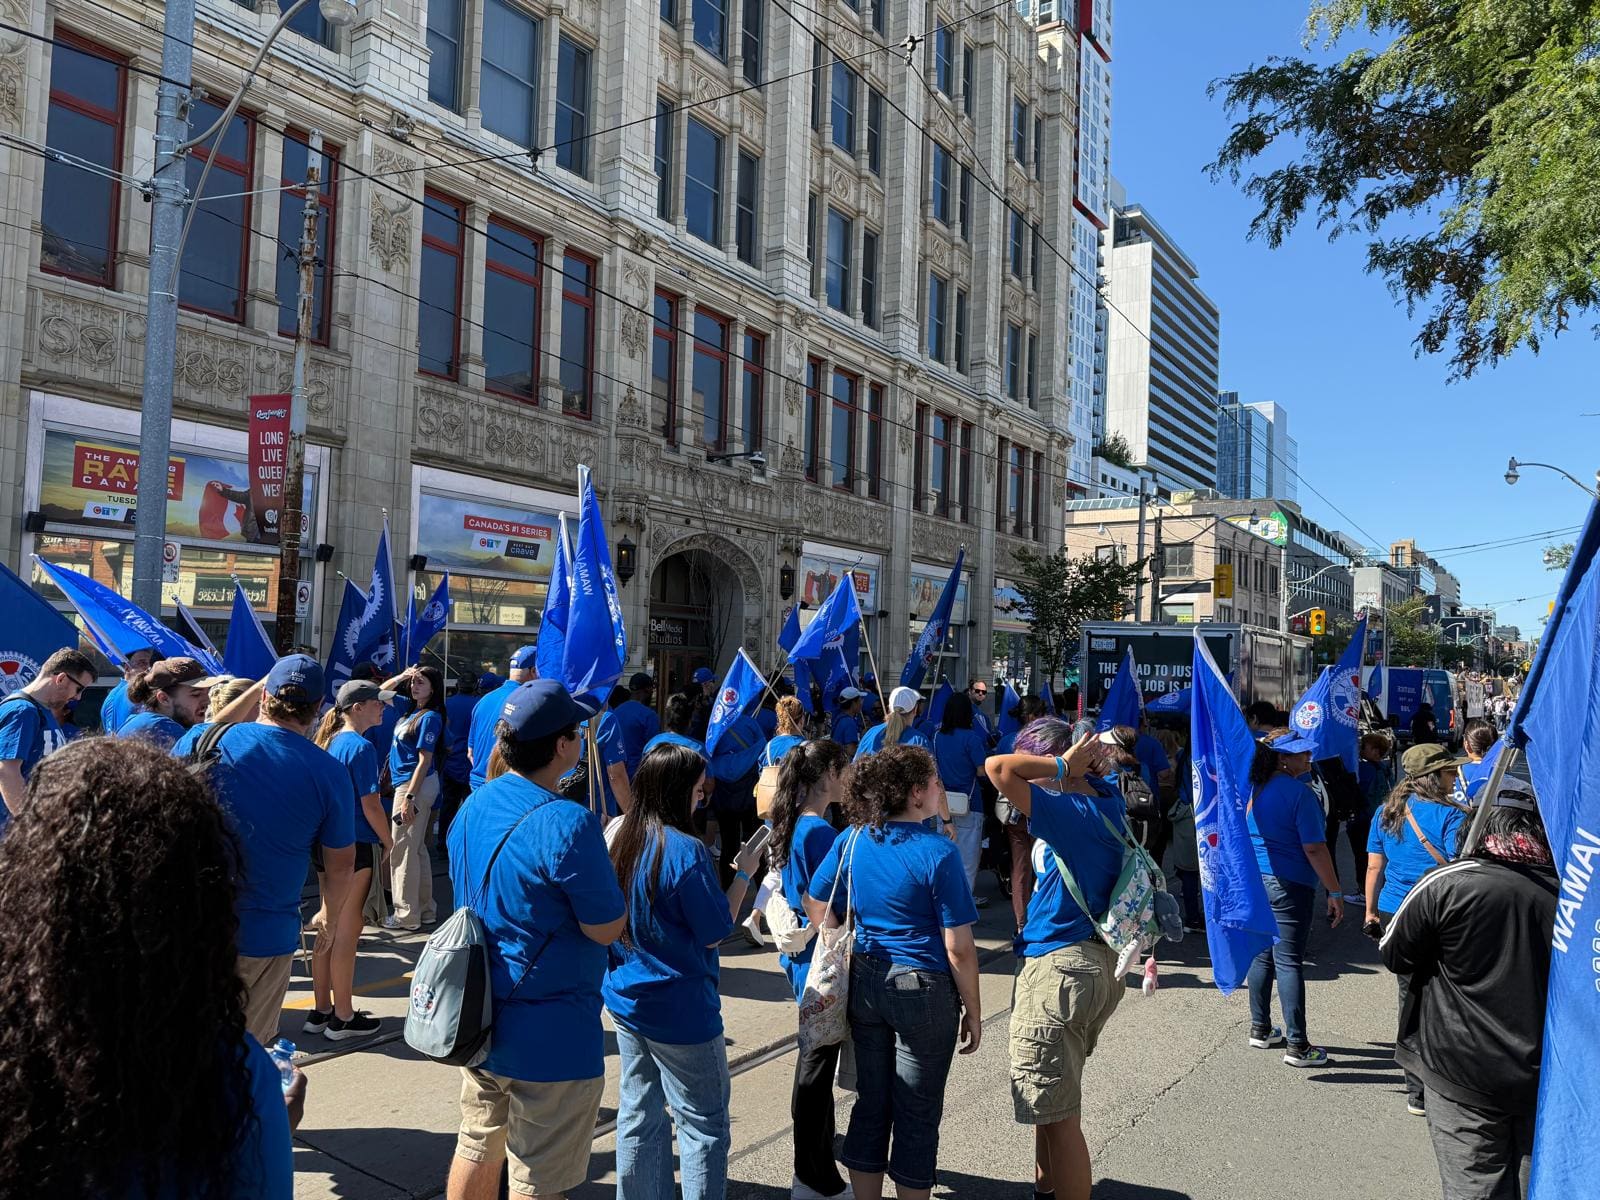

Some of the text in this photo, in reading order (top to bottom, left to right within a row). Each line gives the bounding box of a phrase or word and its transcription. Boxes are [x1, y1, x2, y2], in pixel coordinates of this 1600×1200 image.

[260, 431, 284, 445] LONG
[85, 452, 110, 462] THE
[262, 449, 282, 462] LIVE
[262, 483, 281, 497] WES
[107, 495, 137, 505] TUESD
[93, 506, 120, 516] CTV
[468, 518, 510, 532] CANADA'S
[521, 527, 548, 538] SERIES
[480, 538, 502, 548] CTV
[651, 633, 682, 645] Studios
[1098, 662, 1193, 677] THE AD TO JUS
[1144, 680, 1166, 692] JOB
[1169, 681, 1180, 692] IS
